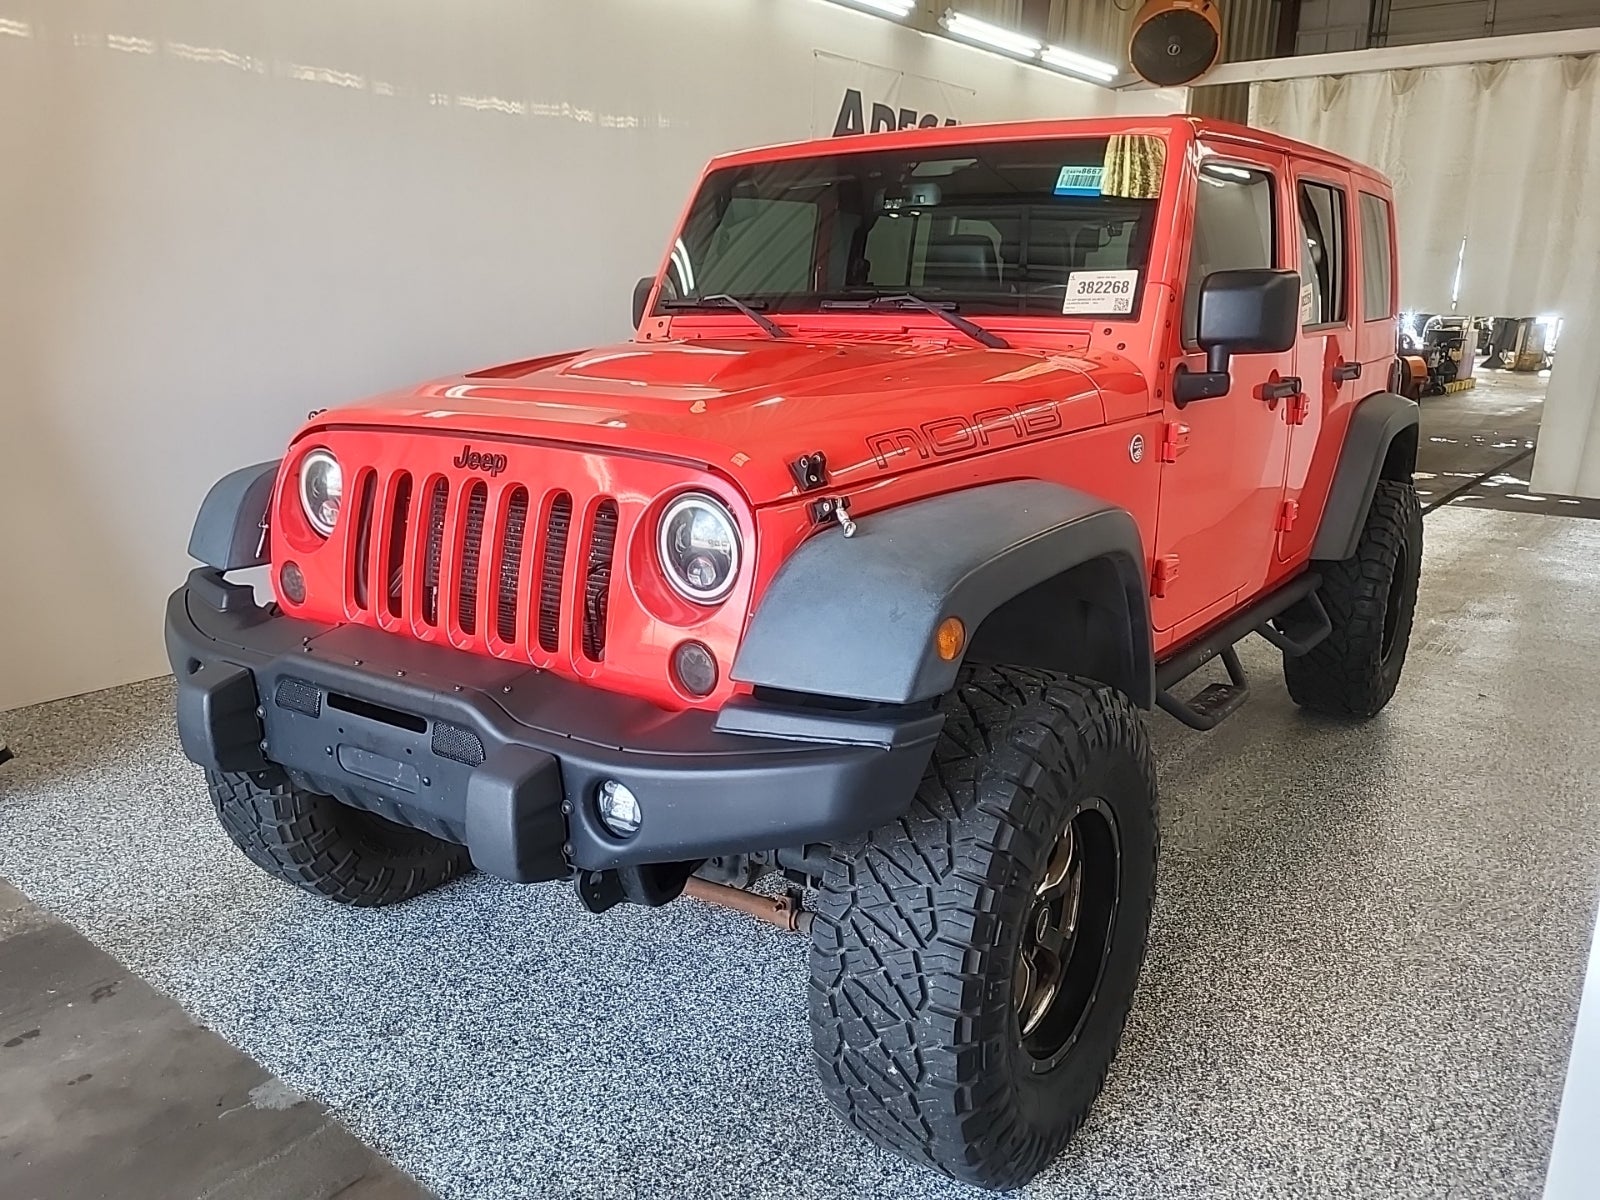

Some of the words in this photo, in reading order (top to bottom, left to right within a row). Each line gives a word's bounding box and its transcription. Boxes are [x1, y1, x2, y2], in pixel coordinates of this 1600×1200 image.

[1077, 281, 1130, 294] 382268
[865, 398, 1063, 469] MOAB
[453, 444, 508, 478] Jeep
